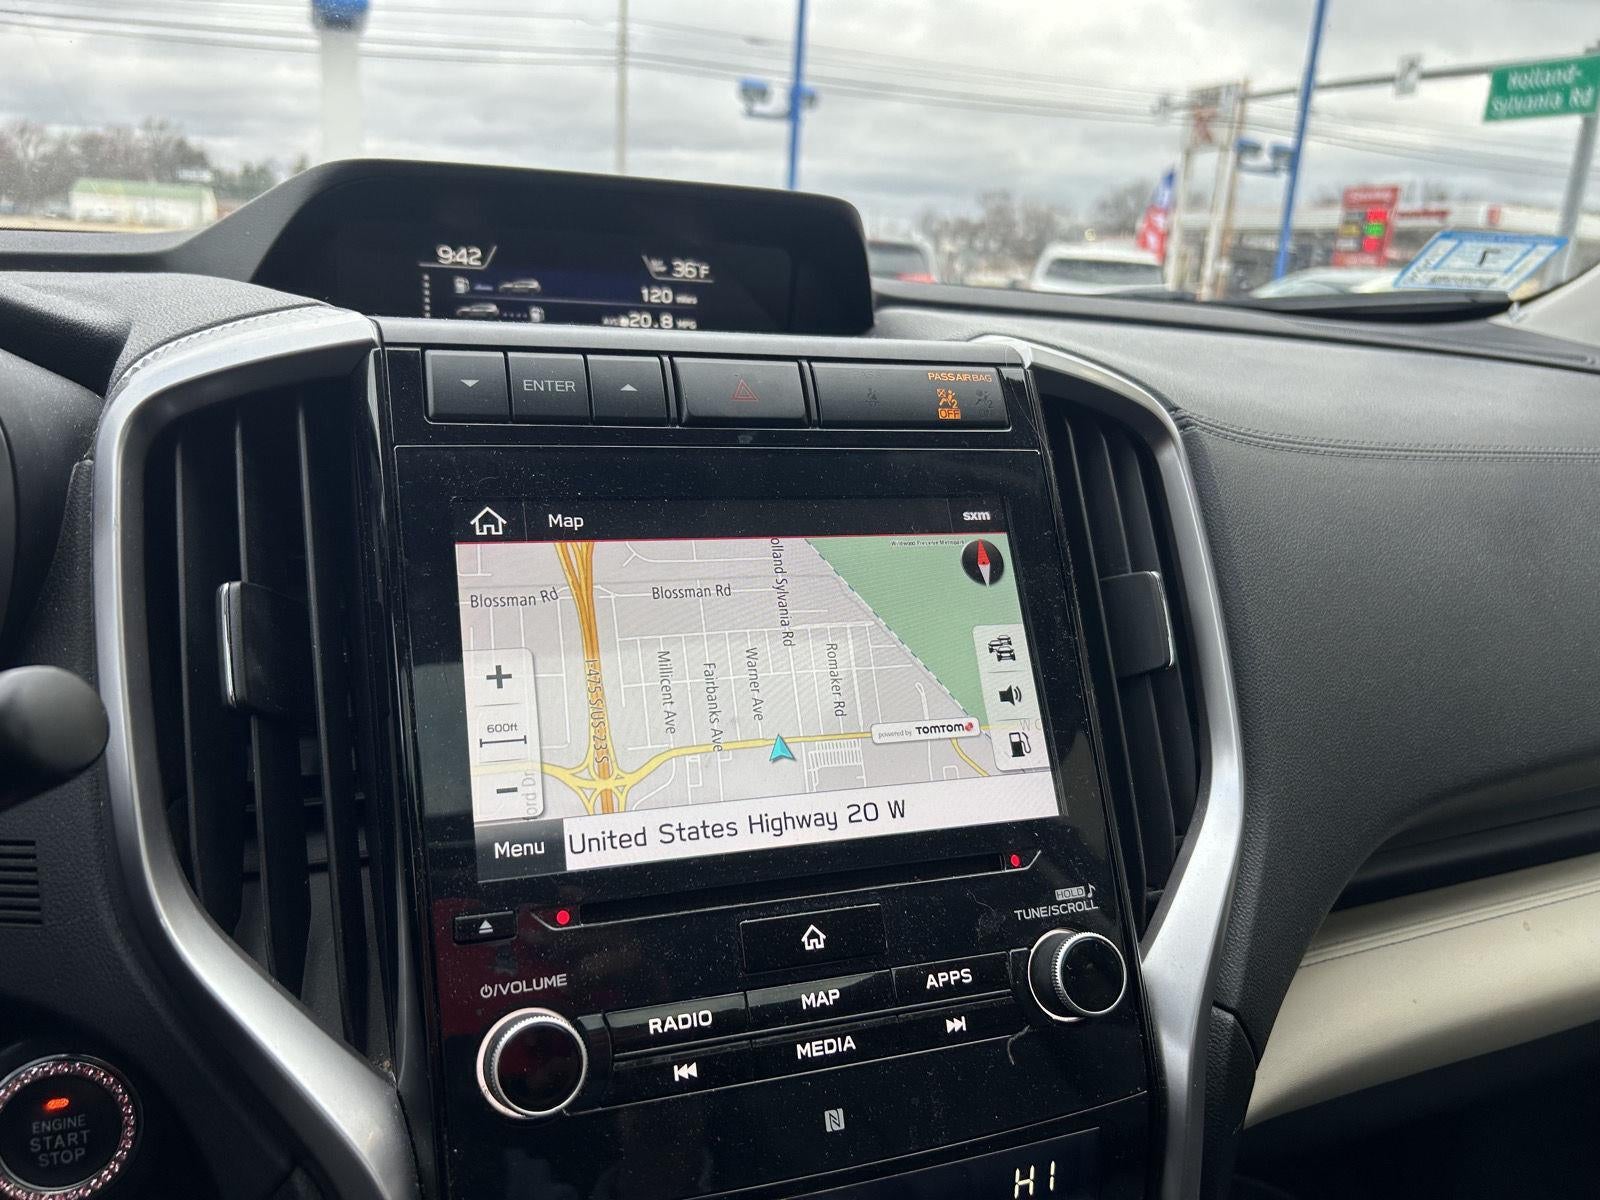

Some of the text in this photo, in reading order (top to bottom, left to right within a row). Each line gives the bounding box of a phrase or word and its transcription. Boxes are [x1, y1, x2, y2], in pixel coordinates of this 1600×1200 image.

[437, 244, 482, 266] 9:42
[641, 286, 673, 304] 120
[628, 311, 674, 329] 20.8
[523, 379, 576, 393] ENTER
[939, 409, 960, 419] OFF
[548, 513, 584, 531] Map
[963, 511, 991, 522] sxm
[470, 587, 559, 609] Blossman Rd
[652, 583, 732, 600] Blossman Rd
[772, 578, 790, 631] Sylvania
[782, 631, 796, 647] Rd
[585, 659, 602, 693] I-475
[746, 647, 764, 721] Warner Ave
[826, 643, 847, 717] Romaker Rd
[657, 651, 677, 735] Millicent Ave
[704, 663, 723, 752] Fairbanks Ave
[878, 730, 905, 739] powered
[905, 729, 912, 737] by
[521, 792, 538, 819] ord
[568, 799, 905, 855] United States Highway 20 W
[494, 841, 545, 859] Menu
[1056, 887, 1084, 900] HOLD
[1014, 900, 1099, 921] TUNE/SCROLL
[925, 968, 972, 989] APPS
[801, 988, 840, 1010] MAP
[648, 1009, 713, 1034] RADIO
[796, 1035, 856, 1059] MEDIA
[32, 1114, 86, 1135] ENGINE
[30, 1129, 90, 1152] START
[38, 1147, 86, 1167] STOP
